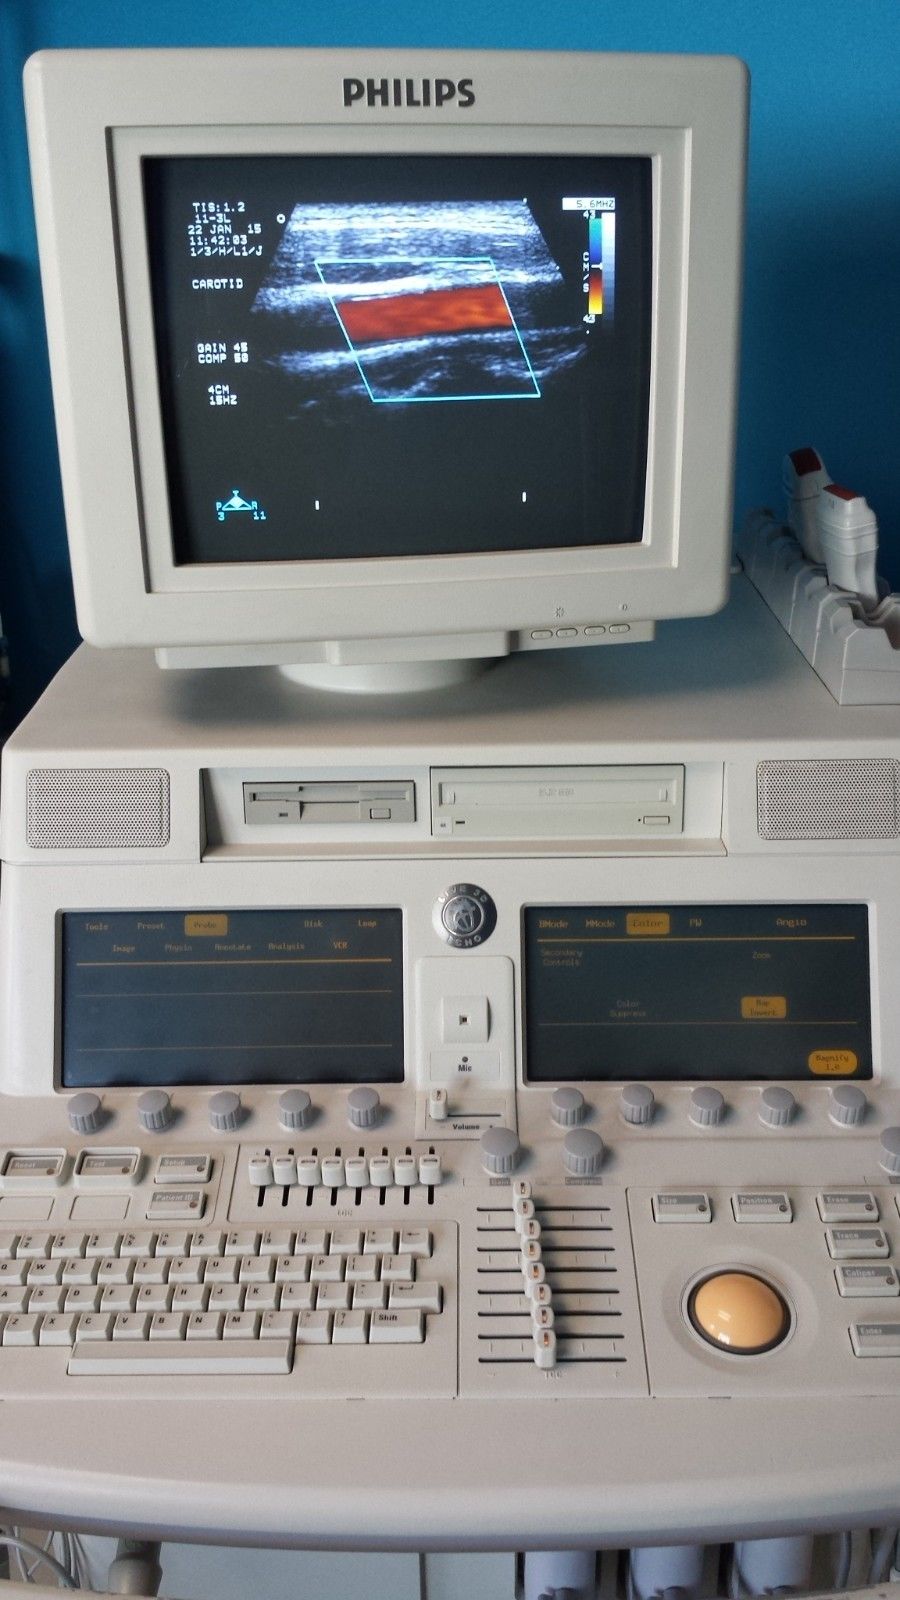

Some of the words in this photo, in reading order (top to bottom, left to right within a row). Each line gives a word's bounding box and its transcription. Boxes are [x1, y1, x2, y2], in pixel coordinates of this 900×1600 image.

[343, 78, 476, 108] PHILIPS
[192, 201, 246, 213] TIS:1.2
[195, 213, 232, 224] 11-3L
[187, 225, 203, 235] 22
[209, 224, 232, 235] JAN
[247, 223, 262, 234] 15
[189, 235, 248, 246] 11:42:03
[190, 245, 263, 257] 1/3/H/L1/J
[191, 278, 244, 290] CAROTID
[197, 343, 227, 354] GAIN
[233, 342, 248, 353] 45
[197, 353, 227, 364] COMP
[233, 352, 249, 363] 50
[207, 384, 230, 396] 4CM
[217, 511, 225, 521] 3
[253, 511, 267, 520] 11
[458, 1064, 473, 1072] Mic
[452, 1123, 480, 1131] Volume
